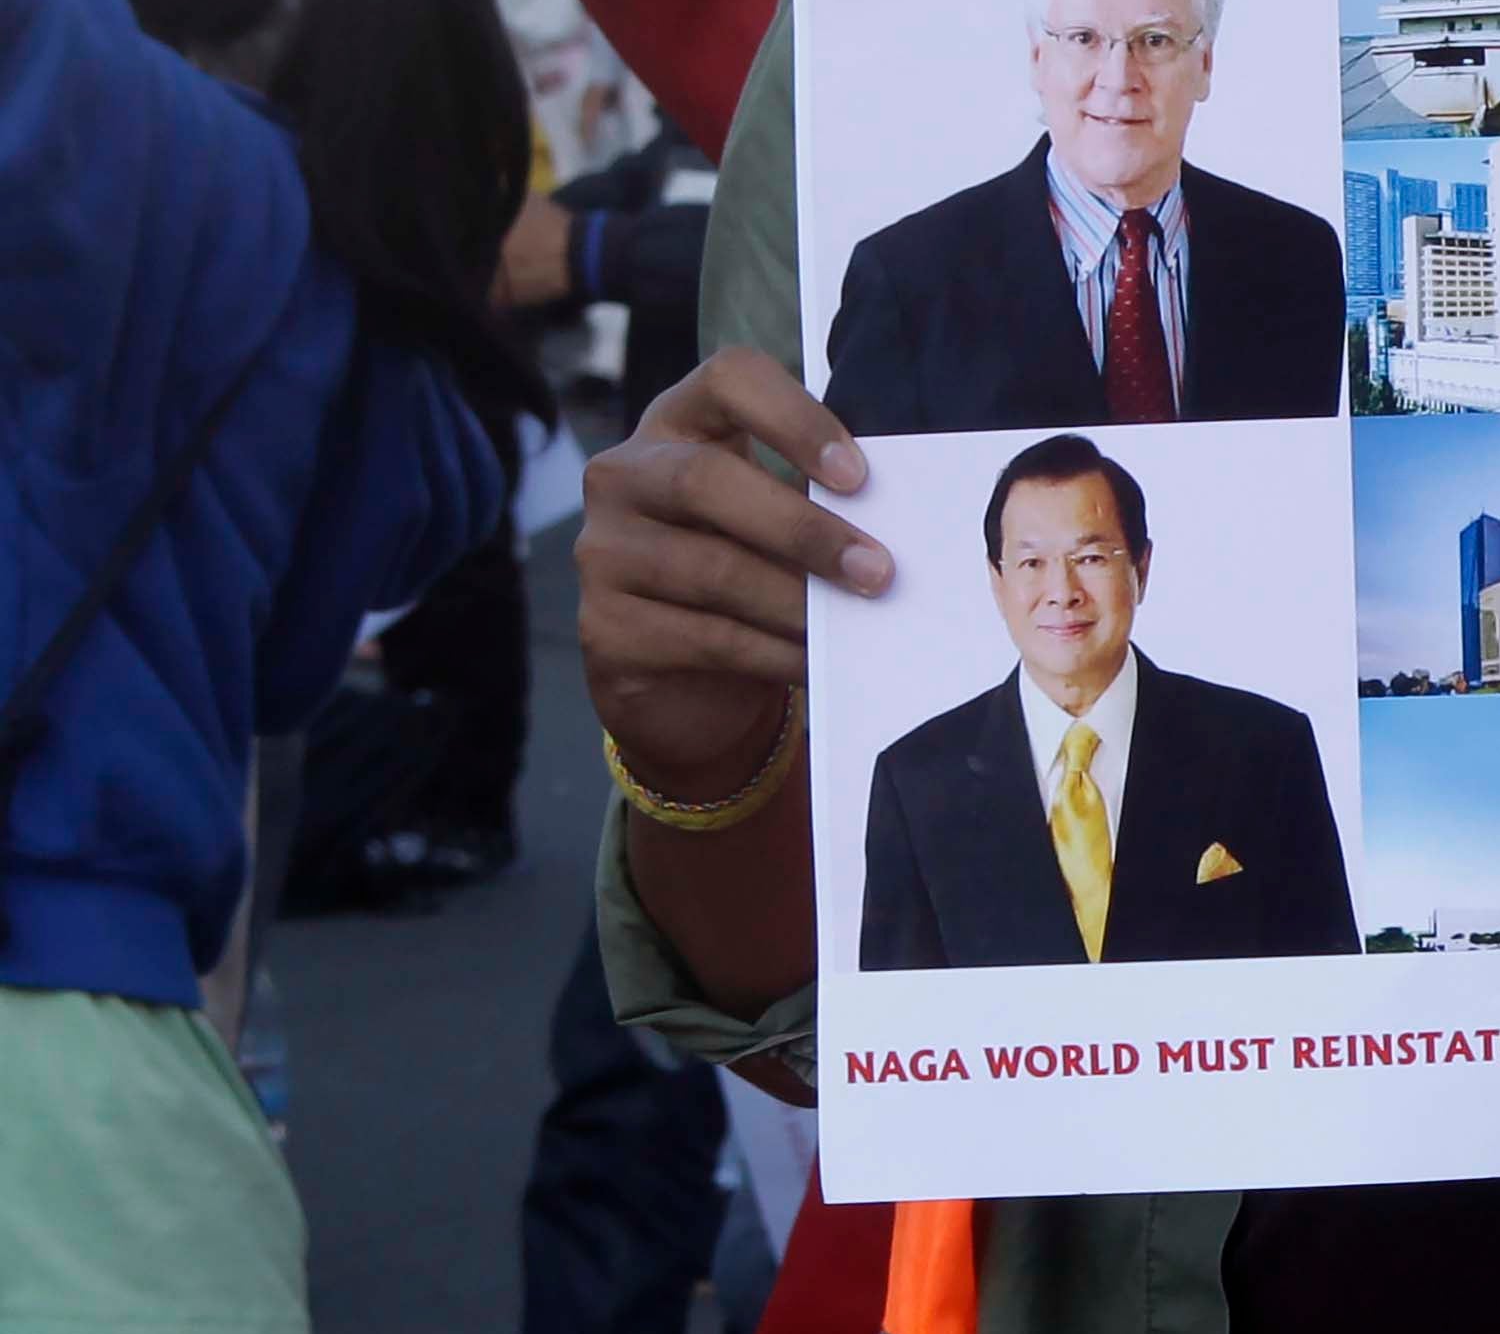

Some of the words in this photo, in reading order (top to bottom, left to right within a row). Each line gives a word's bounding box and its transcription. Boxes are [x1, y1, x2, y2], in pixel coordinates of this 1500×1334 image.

[845, 1048, 971, 1084] NAGA
[983, 1042, 1140, 1080] WORLD
[1156, 1037, 1275, 1074] MUST
